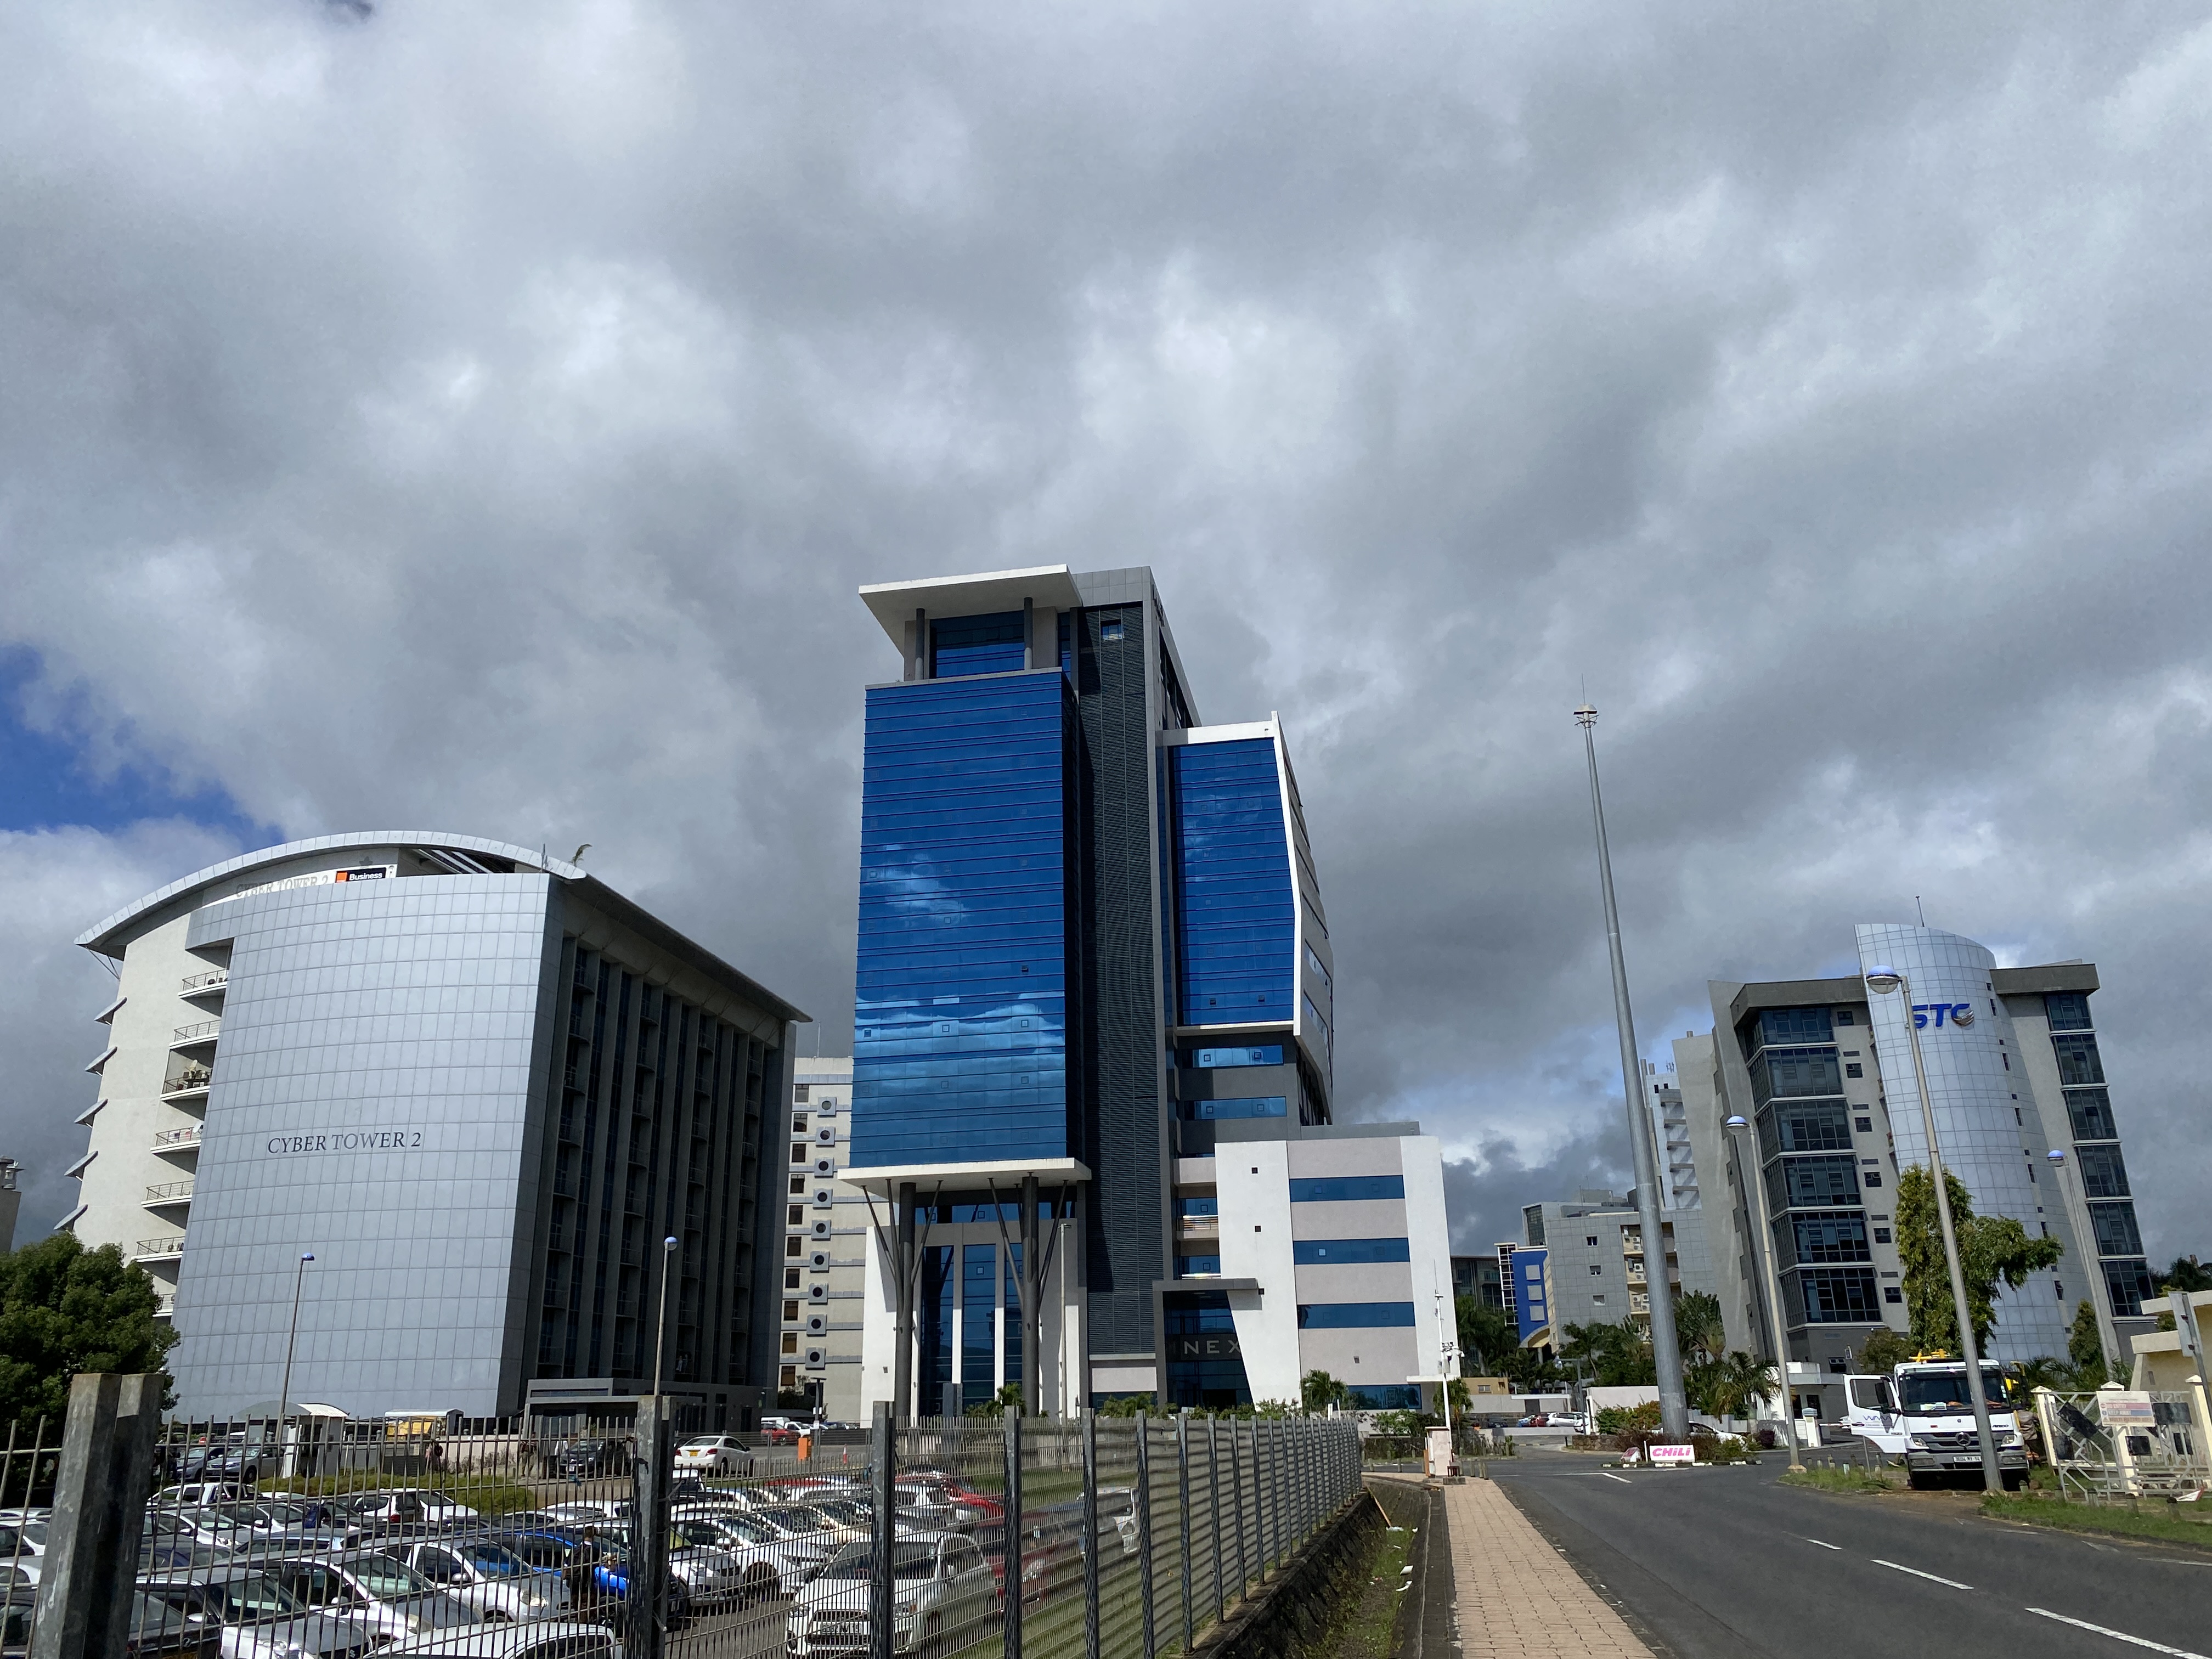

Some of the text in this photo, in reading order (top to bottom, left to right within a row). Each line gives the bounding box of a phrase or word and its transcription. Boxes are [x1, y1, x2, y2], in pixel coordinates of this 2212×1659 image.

[278, 876, 318, 891] TOWER
[349, 872, 382, 881] Business
[1912, 1003, 1974, 1029] STC
[268, 1132, 421, 1154] CYBER TOWER 2
